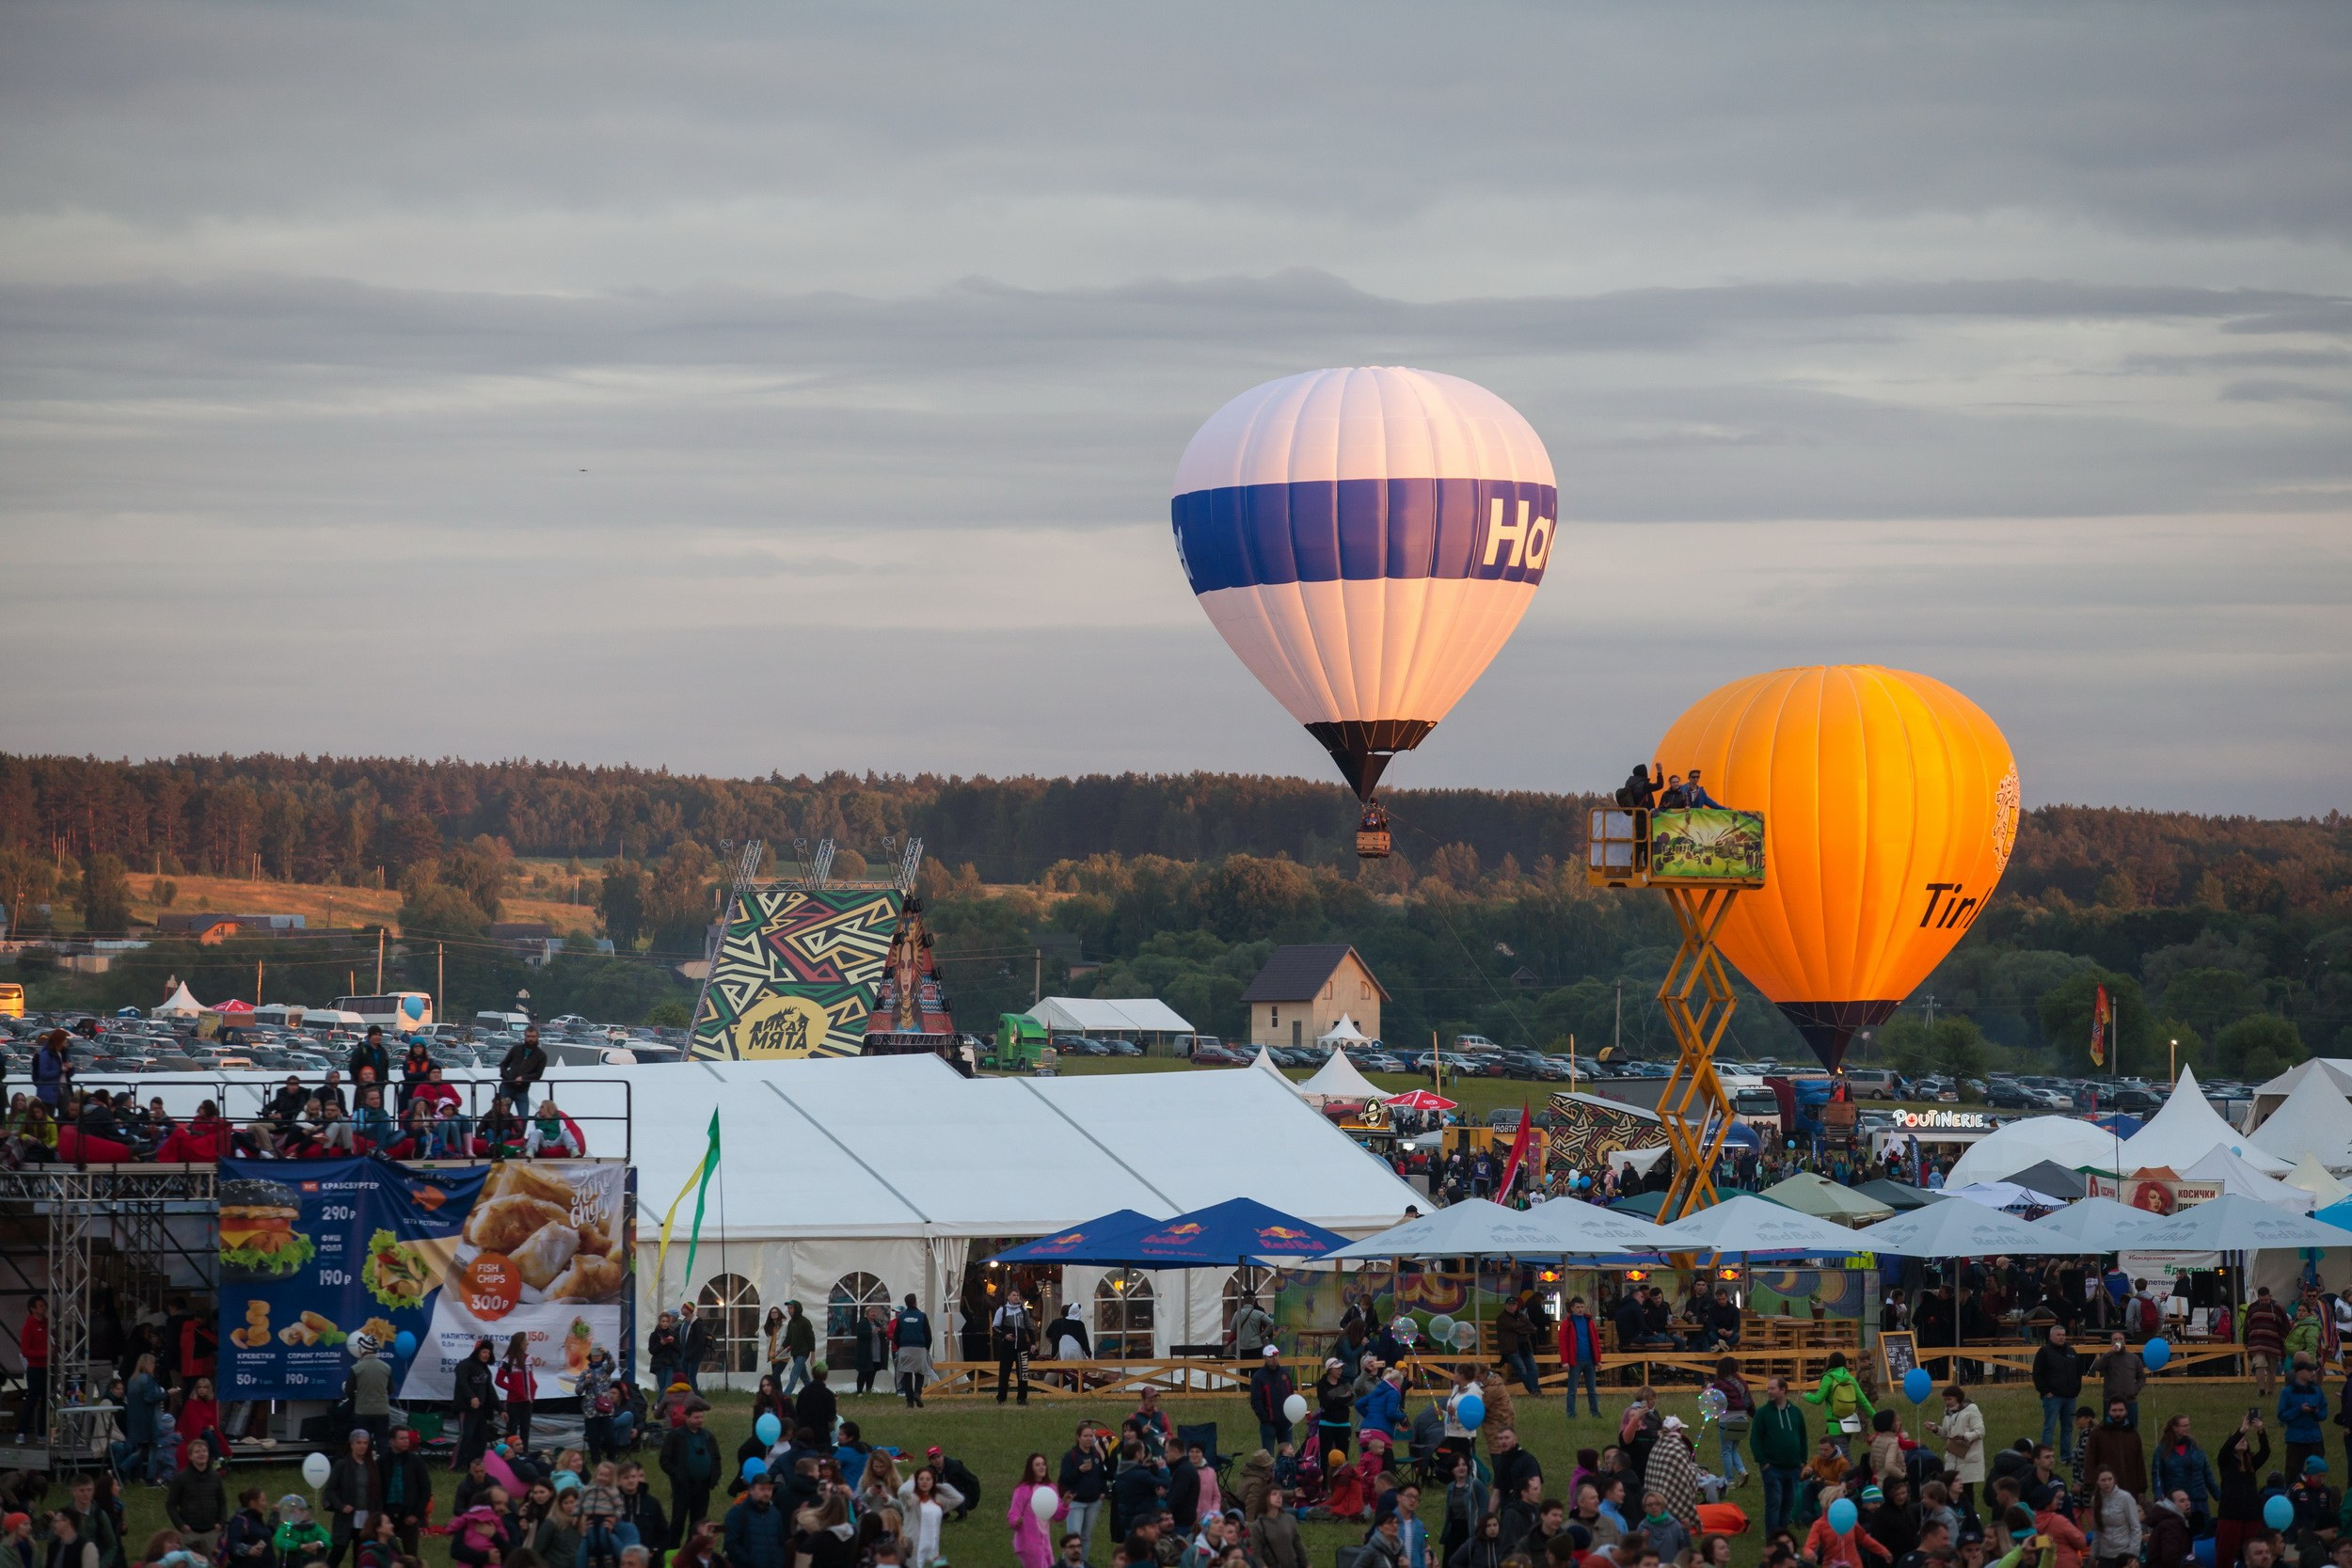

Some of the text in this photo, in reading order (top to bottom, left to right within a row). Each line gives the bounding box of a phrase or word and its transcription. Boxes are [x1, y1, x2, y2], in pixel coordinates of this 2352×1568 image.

[1483, 498, 1557, 571] Ha
[1919, 882, 1994, 929] Tin
[749, 1021, 810, 1034] ДИКАЯ
[748, 1032, 807, 1050] МЯТА
[2178, 1189, 2216, 1198] КОСИЧКИ
[477, 1264, 499, 1273] FISH
[477, 1275, 506, 1284] CHIPS
[440, 1332, 475, 1340] НАПИТОК
